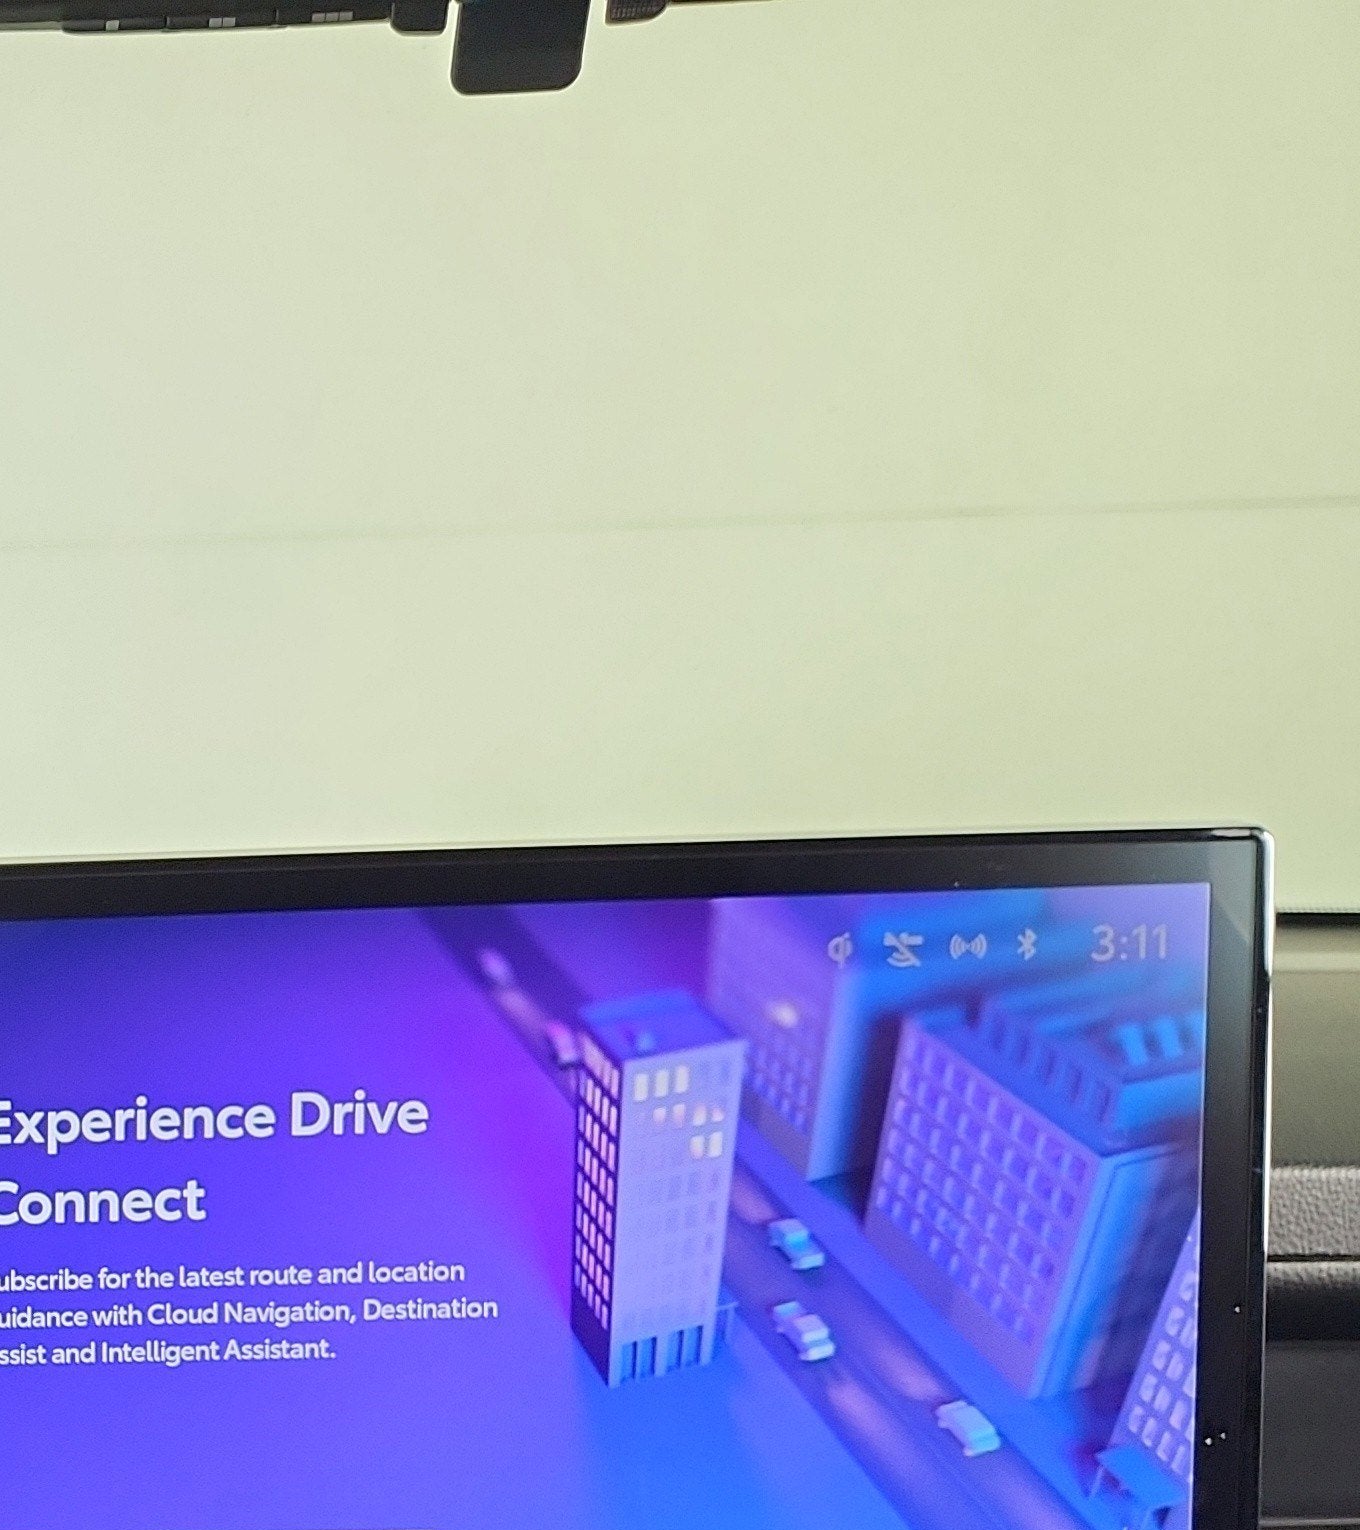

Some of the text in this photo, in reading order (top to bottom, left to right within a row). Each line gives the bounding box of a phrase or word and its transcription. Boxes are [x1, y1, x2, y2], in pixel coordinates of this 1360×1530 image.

[1090, 922, 1169, 963] 3:11
[290, 1089, 429, 1137] Drive
[97, 1267, 132, 1290] for
[135, 1265, 175, 1289] the
[179, 1264, 245, 1288] latest
[249, 1266, 312, 1287] route
[316, 1262, 363, 1285] and
[368, 1260, 466, 1284] location
[91, 1304, 143, 1328] with
[146, 1302, 219, 1326] Cloud
[223, 1300, 358, 1328] Navigation,
[362, 1297, 499, 1322] Destination
[51, 1341, 97, 1365] and
[101, 1338, 221, 1368] Intelligent
[223, 1337, 337, 1362] Assistant.
